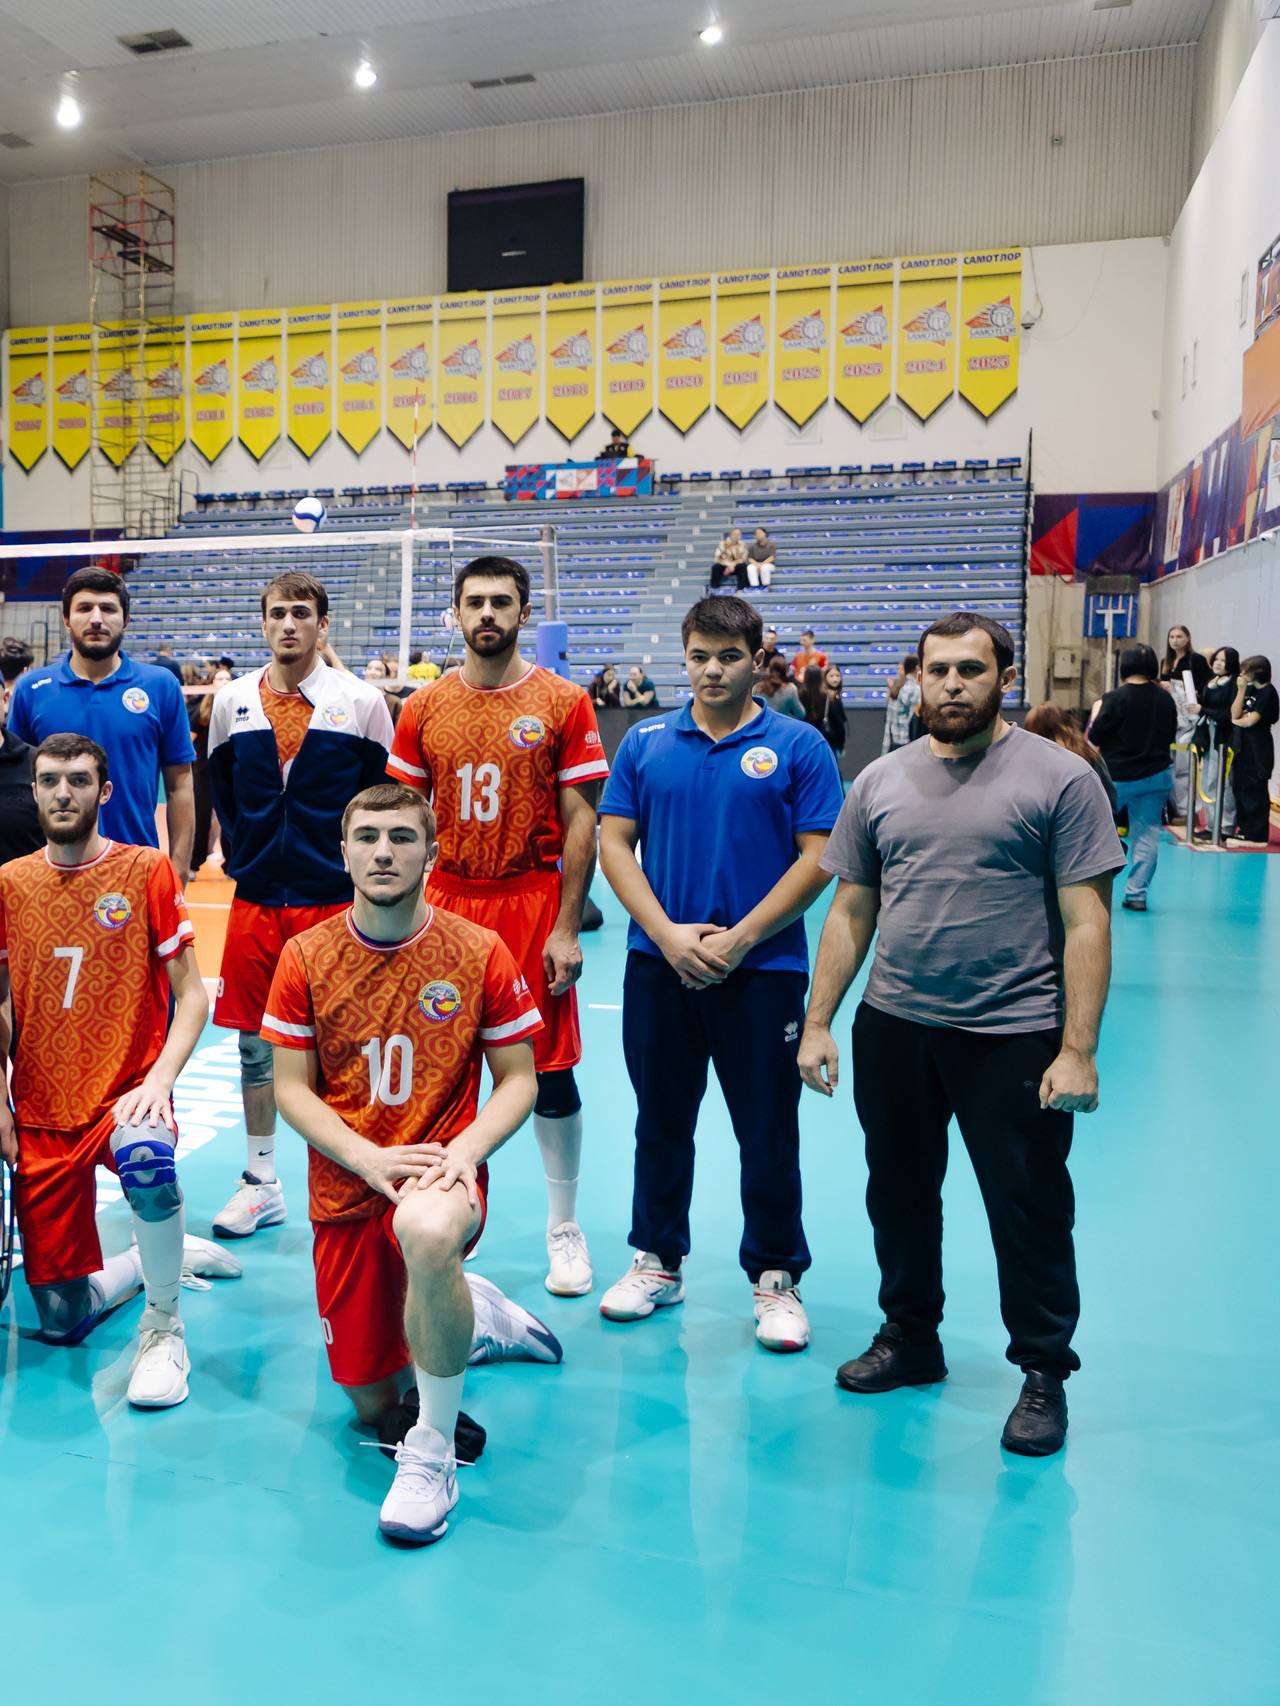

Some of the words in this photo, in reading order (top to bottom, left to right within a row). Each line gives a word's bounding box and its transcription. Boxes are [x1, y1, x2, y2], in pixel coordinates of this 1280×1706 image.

[900, 258, 957, 269] САМОТЛОР
[963, 252, 1021, 265] САМОТЛОР
[838, 262, 893, 274] САМОТЛОР
[717, 274, 769, 285] САМОТЛОР
[776, 269, 830, 279] САМОТЛОР
[602, 285, 652, 295] САМОТЛОР
[659, 279, 709, 290] САМОТЛОР
[456, 763, 501, 823] 13
[54, 946, 84, 1009] 7
[361, 1034, 415, 1107] 10
